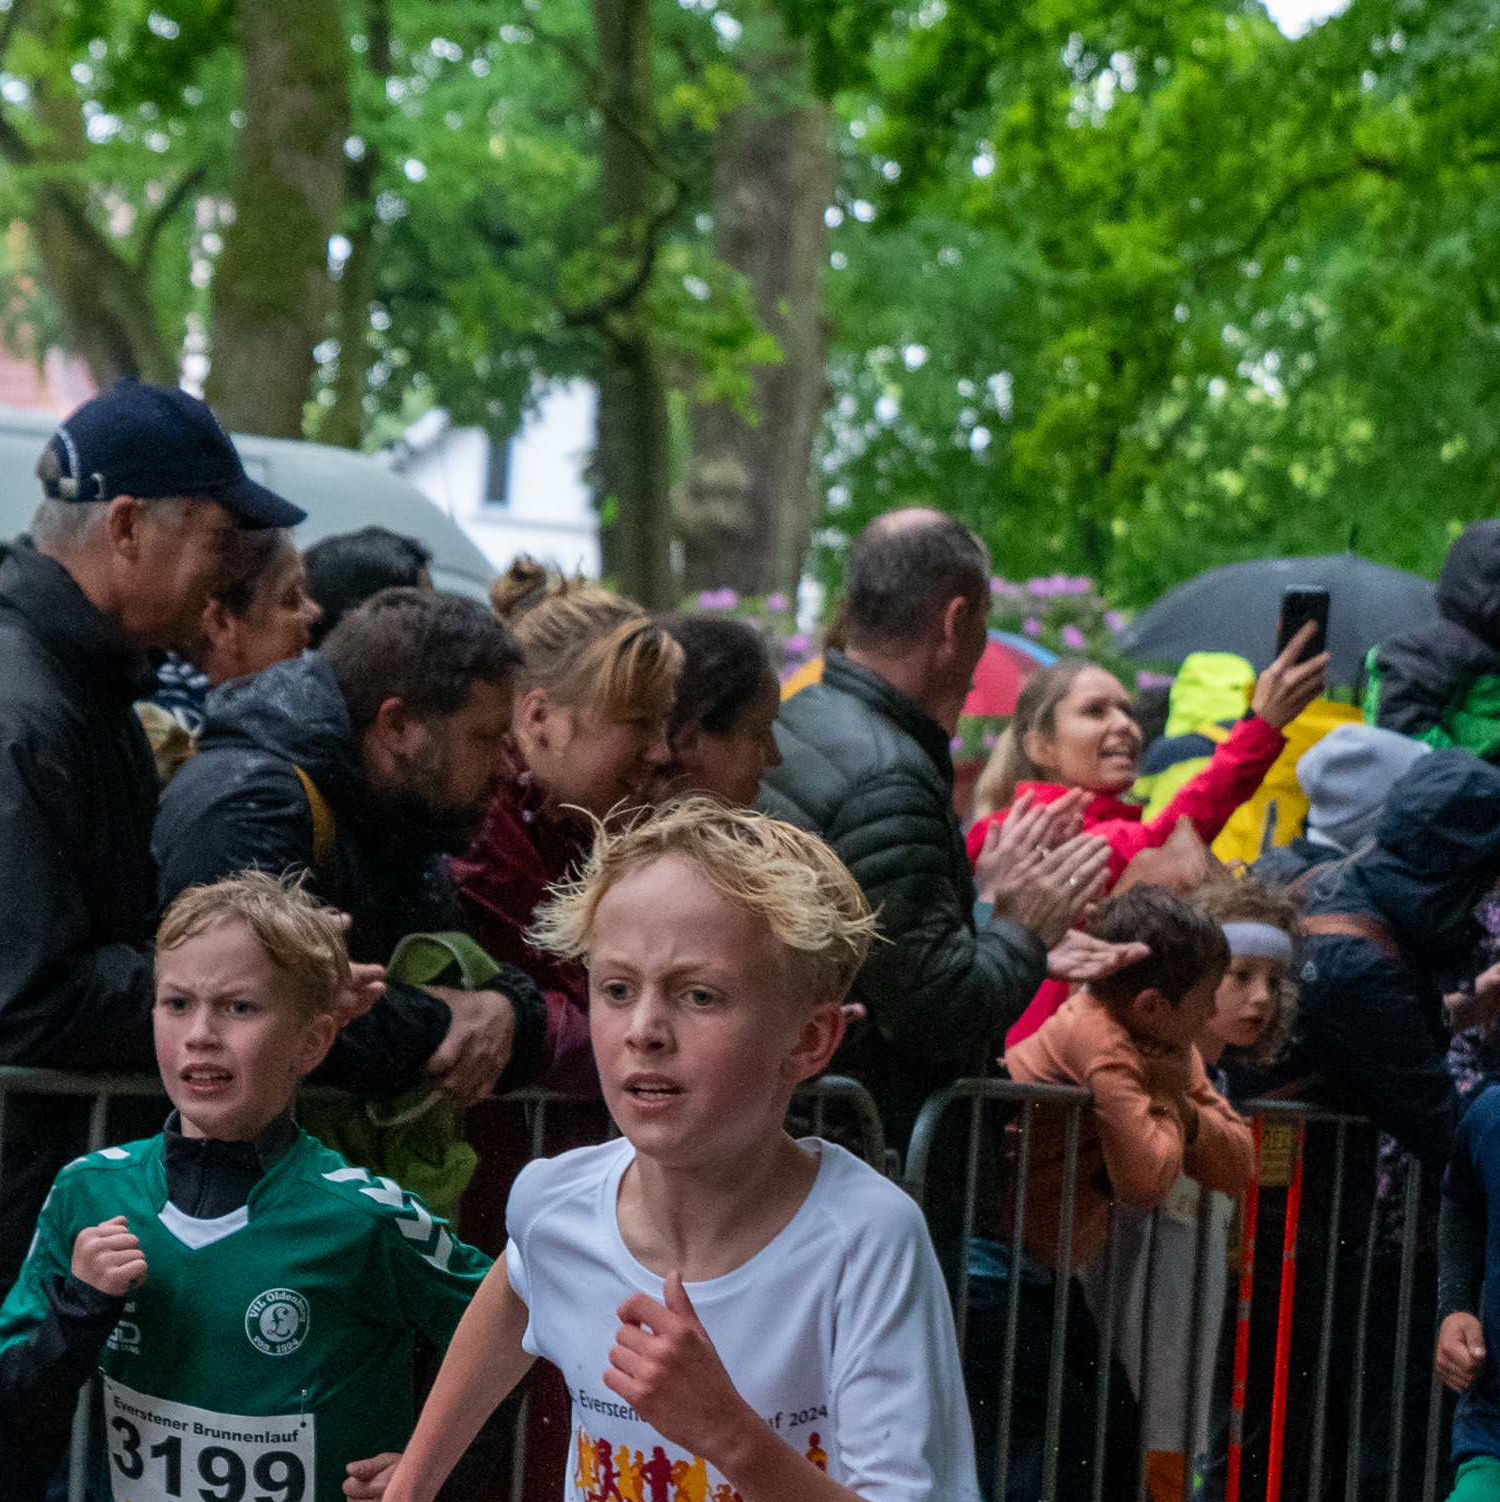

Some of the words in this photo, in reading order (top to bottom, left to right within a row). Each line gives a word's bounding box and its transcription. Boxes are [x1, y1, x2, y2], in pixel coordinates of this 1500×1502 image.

[112, 1394, 189, 1431] Everstener
[193, 1422, 299, 1444] Brunnenlauf
[579, 1389, 640, 1422] Eversten
[789, 1403, 828, 1428] 2024
